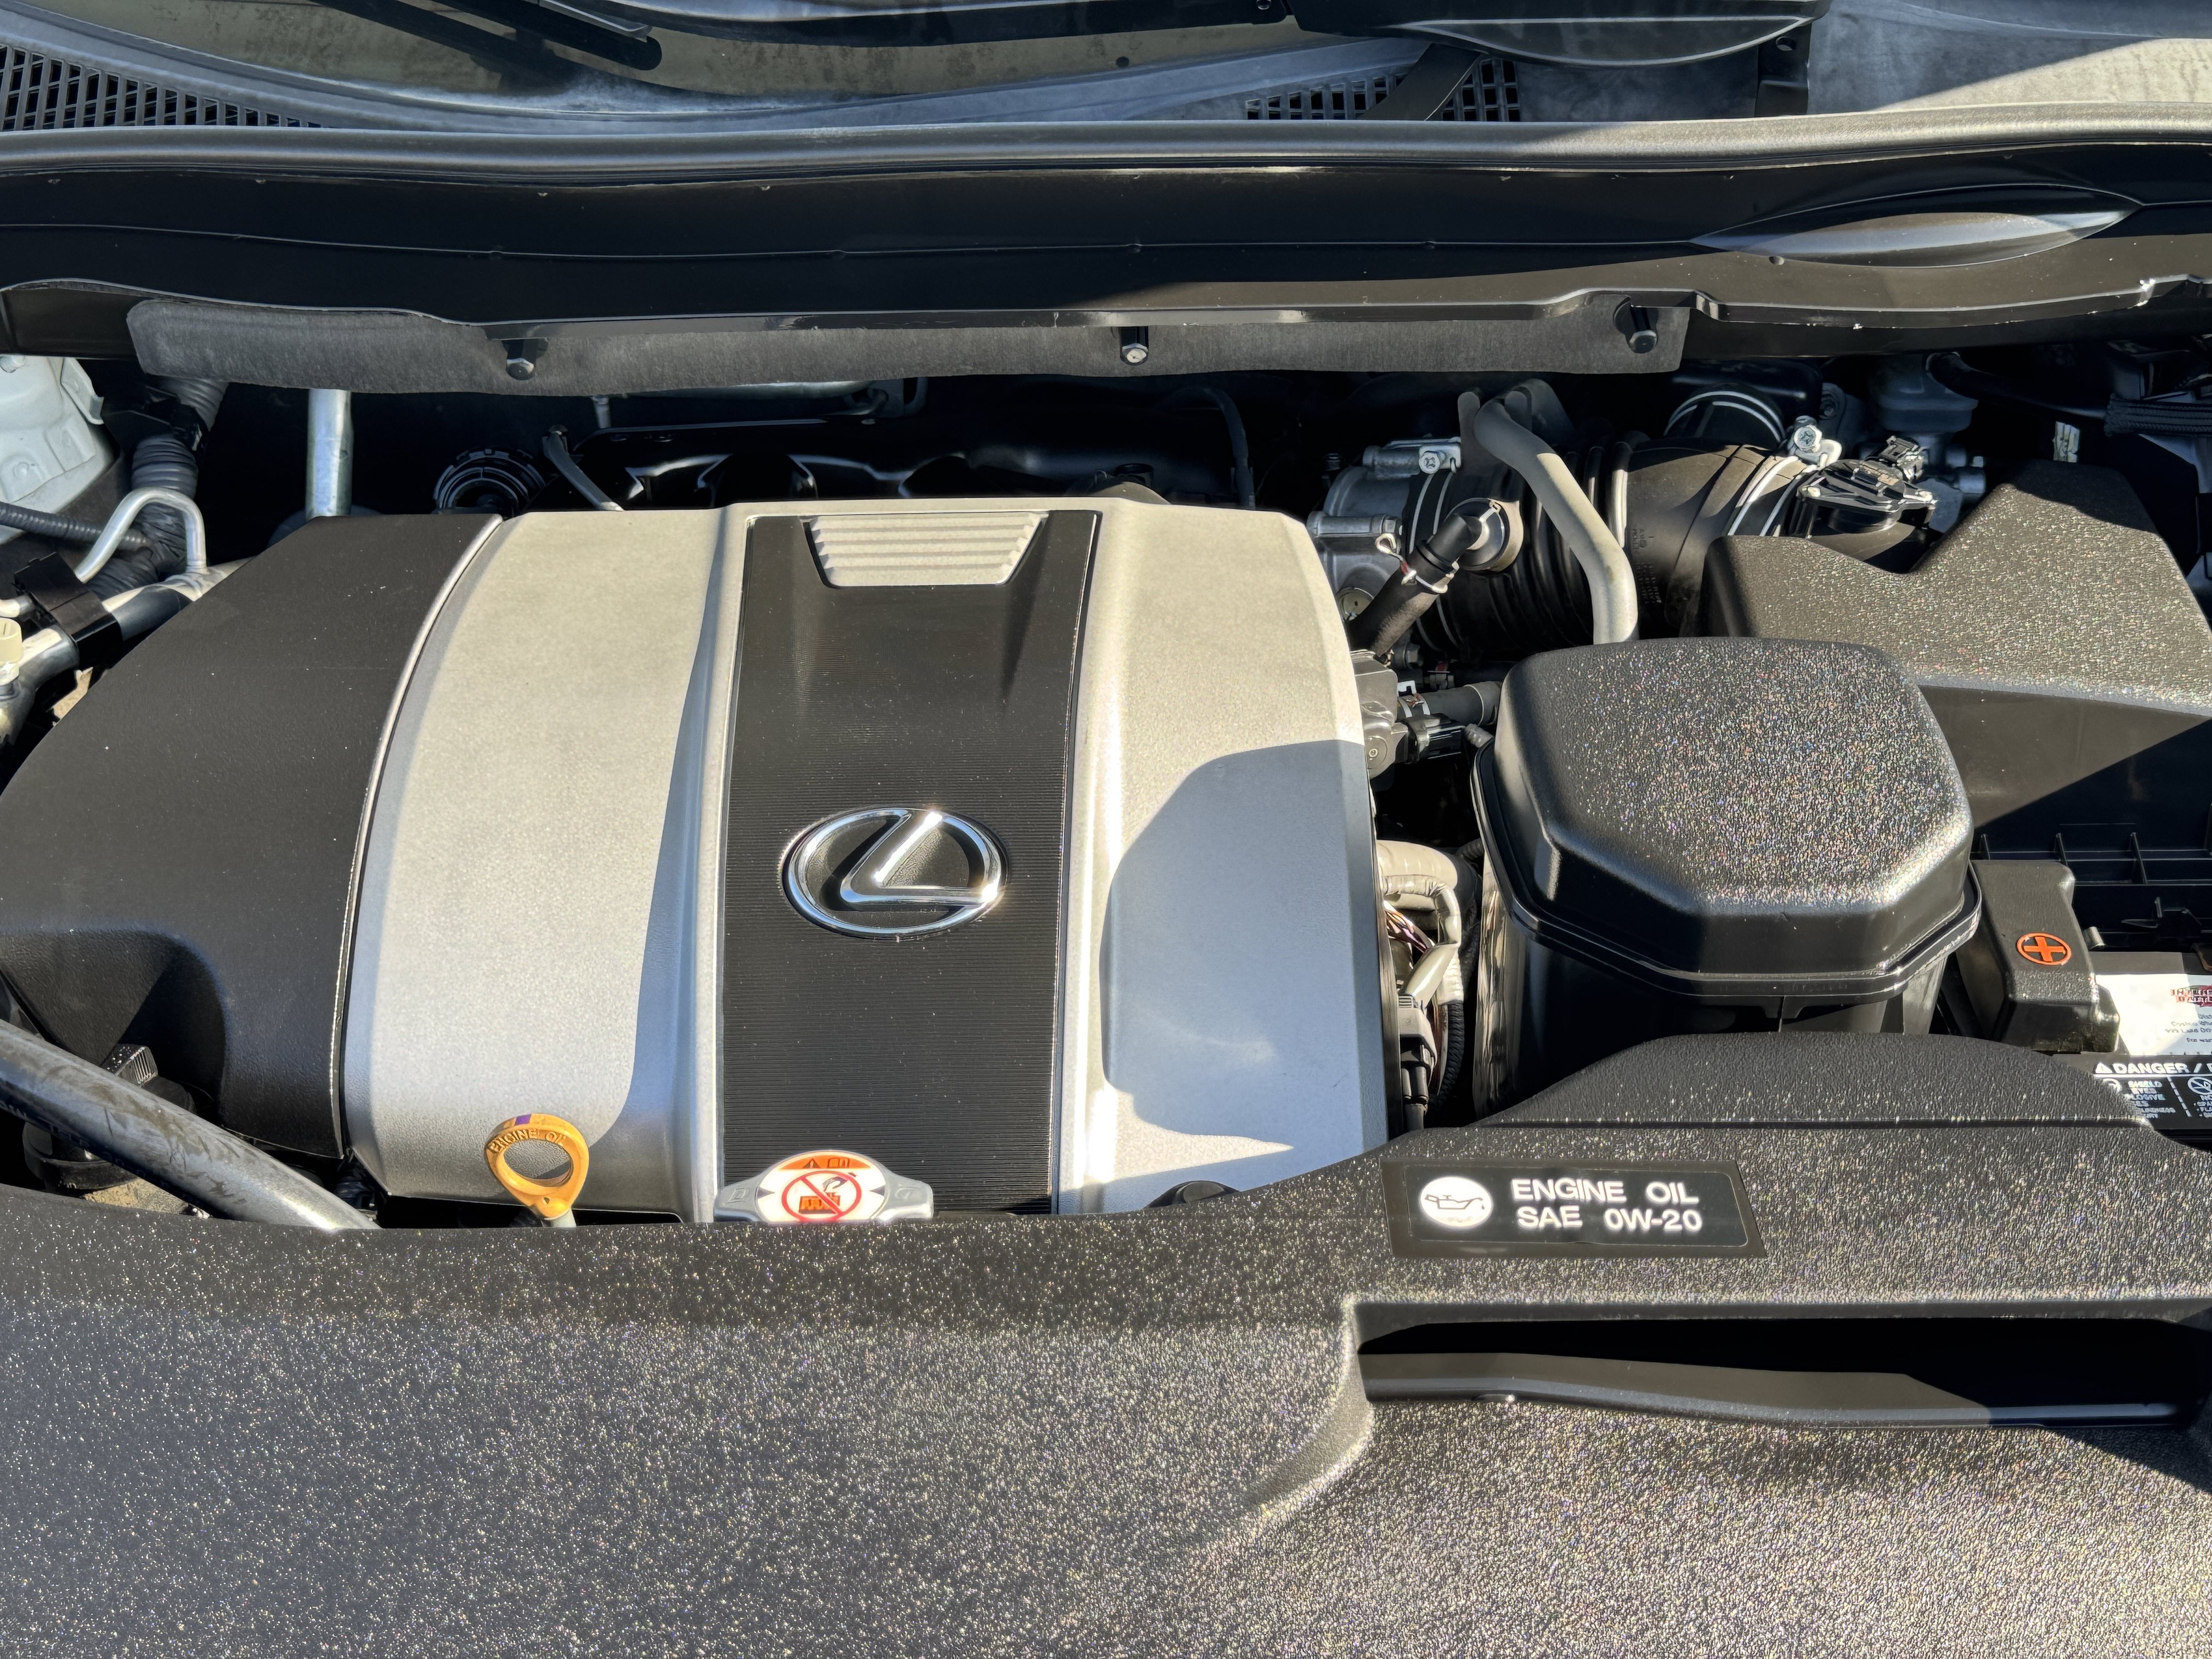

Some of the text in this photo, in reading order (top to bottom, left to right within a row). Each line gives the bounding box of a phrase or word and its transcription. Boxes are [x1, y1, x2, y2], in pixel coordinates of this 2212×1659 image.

[2112, 1063, 2190, 1074] DANGER
[488, 1128, 567, 1153] ENGINE OIL
[1511, 1177, 1700, 1205] ENGINE OIL
[1516, 1205, 1703, 1232] SAE 0W-20
